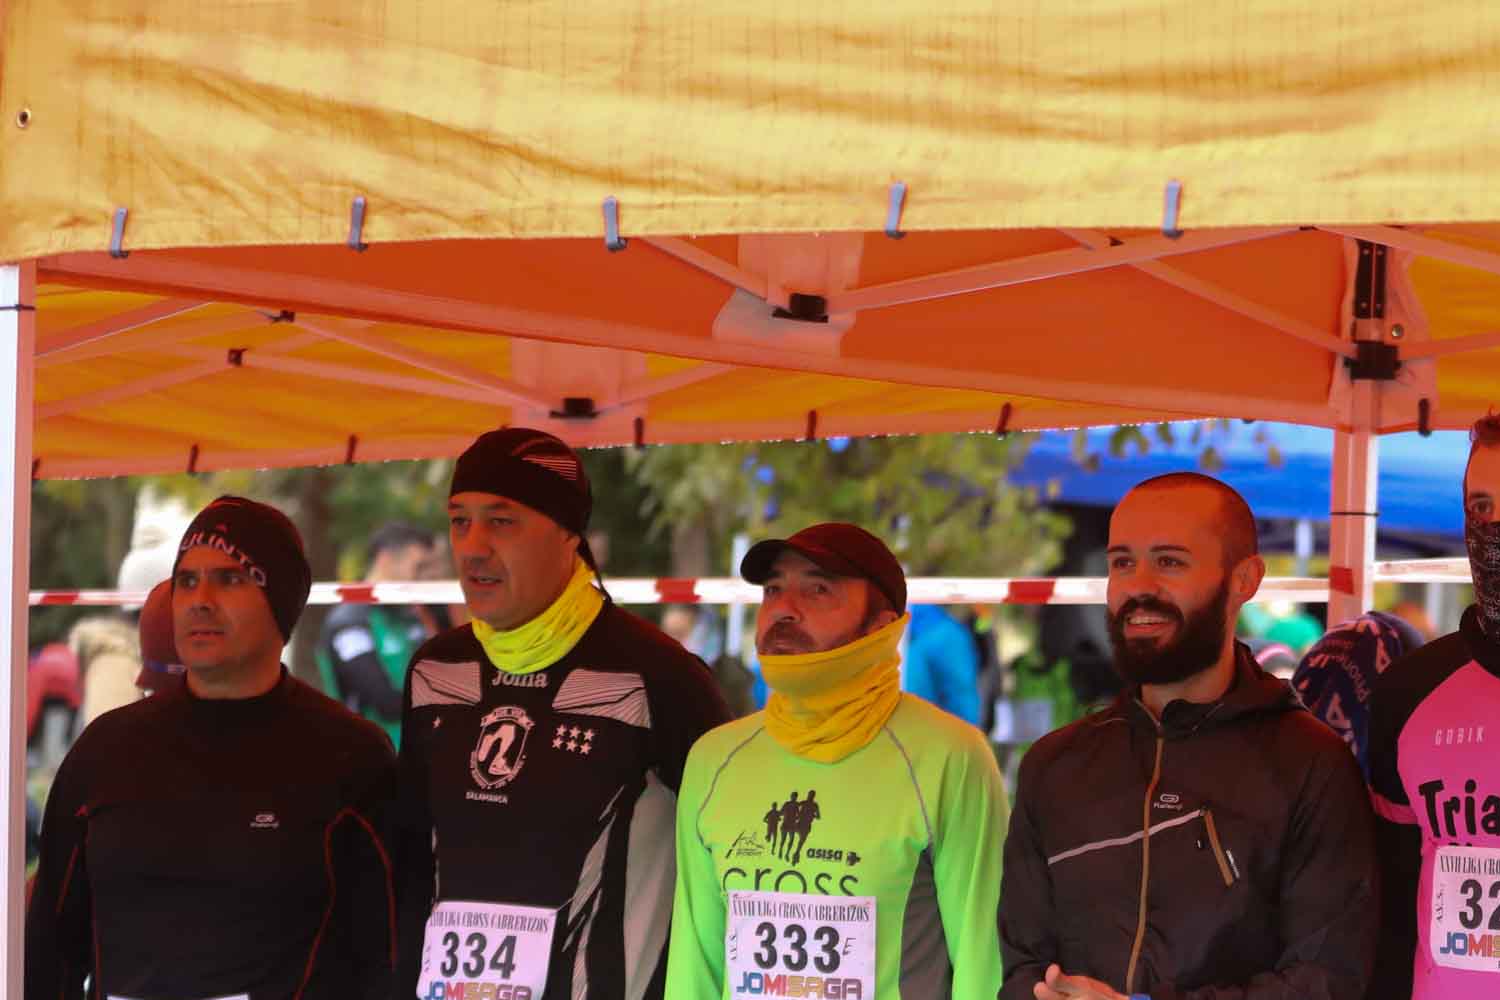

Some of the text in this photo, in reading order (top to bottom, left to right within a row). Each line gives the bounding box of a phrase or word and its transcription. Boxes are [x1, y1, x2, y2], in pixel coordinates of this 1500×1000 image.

[492, 670, 548, 688] Joma
[806, 847, 843, 861] asisa
[1463, 856, 1481, 875] LIGA
[778, 902, 807, 920] CROSS
[808, 903, 871, 922] CABRERIZOS
[439, 931, 518, 980] 334
[753, 921, 841, 974] 333
[736, 971, 863, 1000] JOMISAGA
